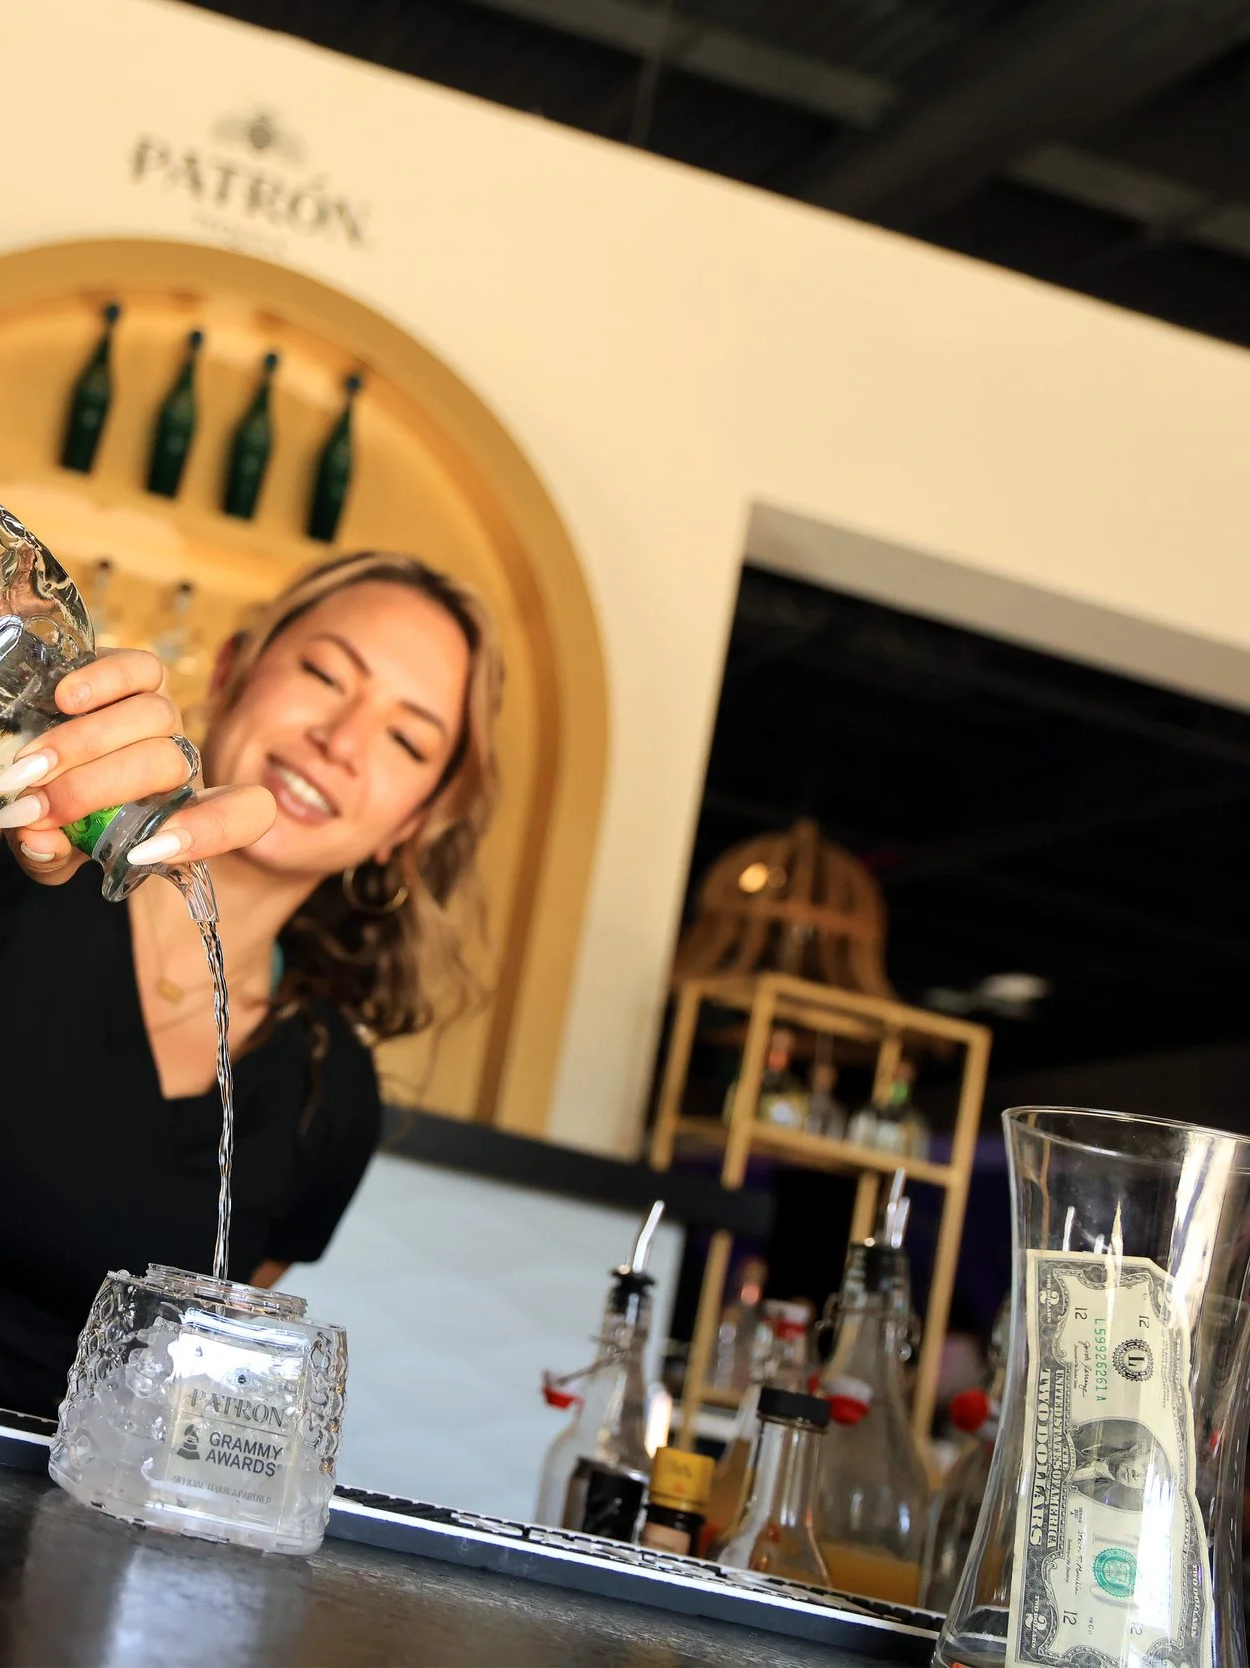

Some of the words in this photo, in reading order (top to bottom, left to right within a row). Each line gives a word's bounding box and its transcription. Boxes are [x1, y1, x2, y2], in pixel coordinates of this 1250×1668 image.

[128, 132, 375, 250] PATRÓN
[1074, 1307, 1088, 1320] 12
[1139, 1315, 1150, 1329] 12
[1128, 1355, 1145, 1368] L
[1037, 1369, 1051, 1422] TWO
[1054, 1370, 1064, 1417] UNITED
[209, 1432, 283, 1460] GRAMMY
[1052, 1417, 1063, 1470] STATES
[205, 1452, 276, 1477] AWARDS
[1029, 1426, 1049, 1546] DOLLARS
[1046, 1486, 1059, 1549] AMERICA
[1063, 1610, 1078, 1625] 12
